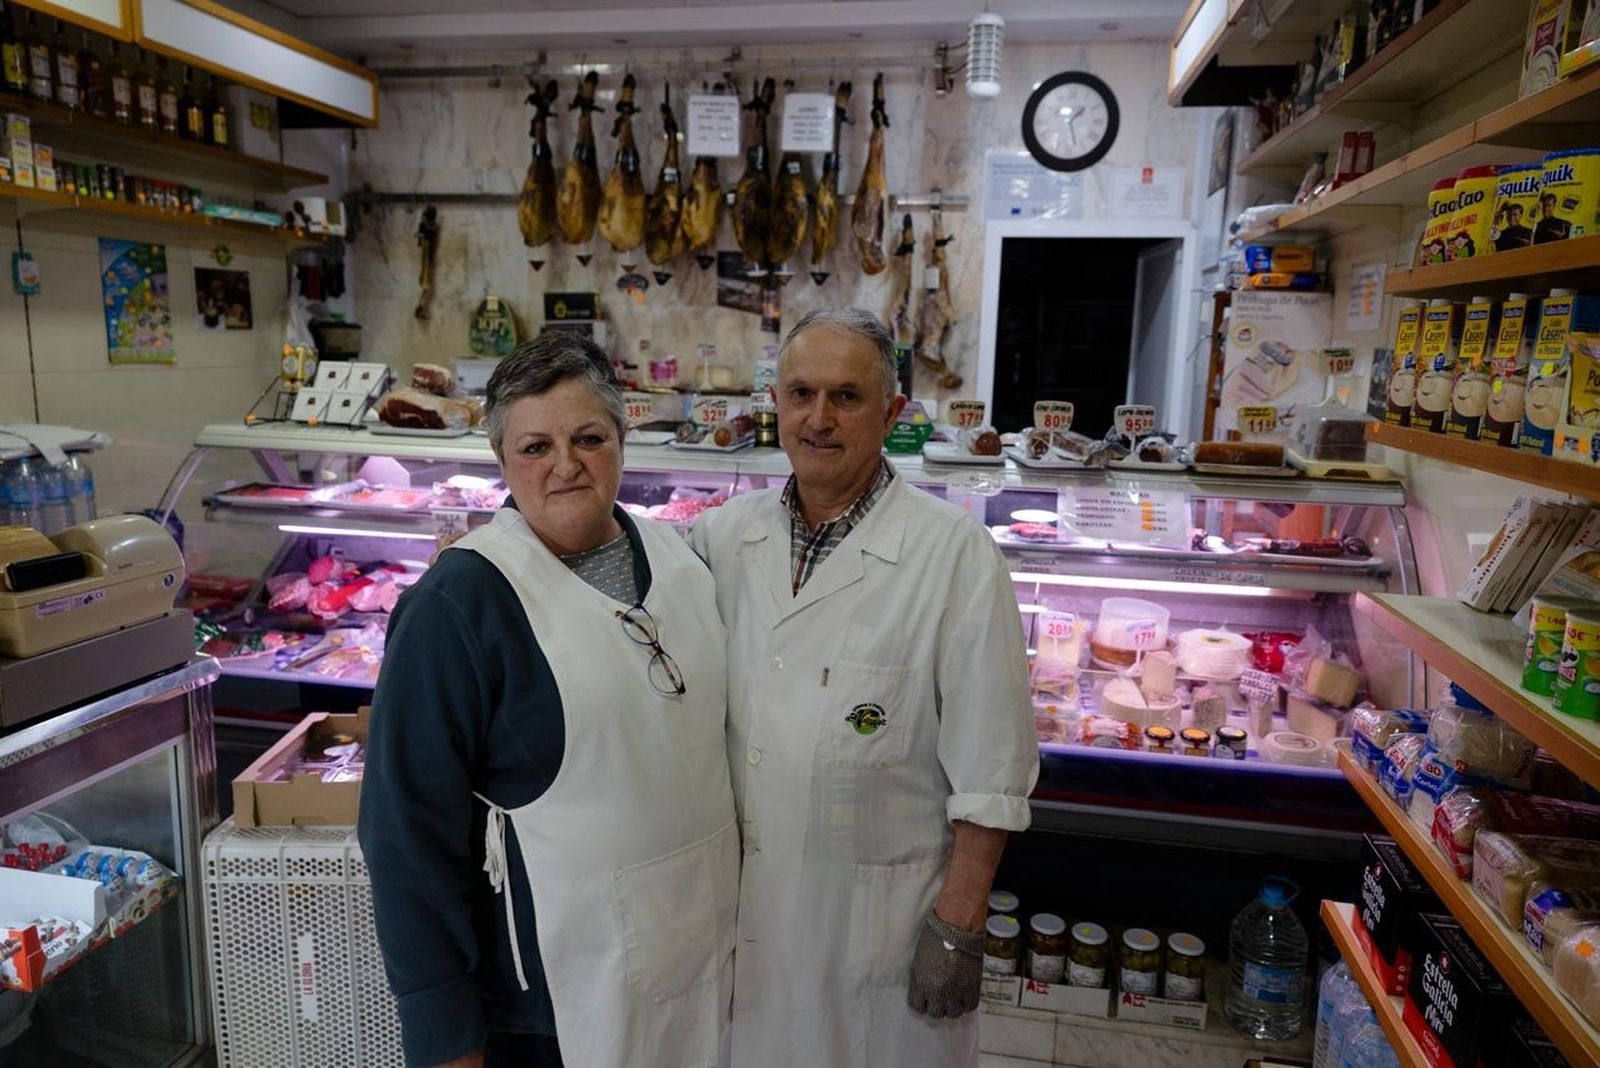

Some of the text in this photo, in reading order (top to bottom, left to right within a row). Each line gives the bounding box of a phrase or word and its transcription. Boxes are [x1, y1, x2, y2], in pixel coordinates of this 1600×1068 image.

[1497, 176, 1541, 197] squik
[1542, 164, 1574, 187] quik
[1422, 972, 1453, 1027] Galicia
[1424, 953, 1458, 1009] Estrella
